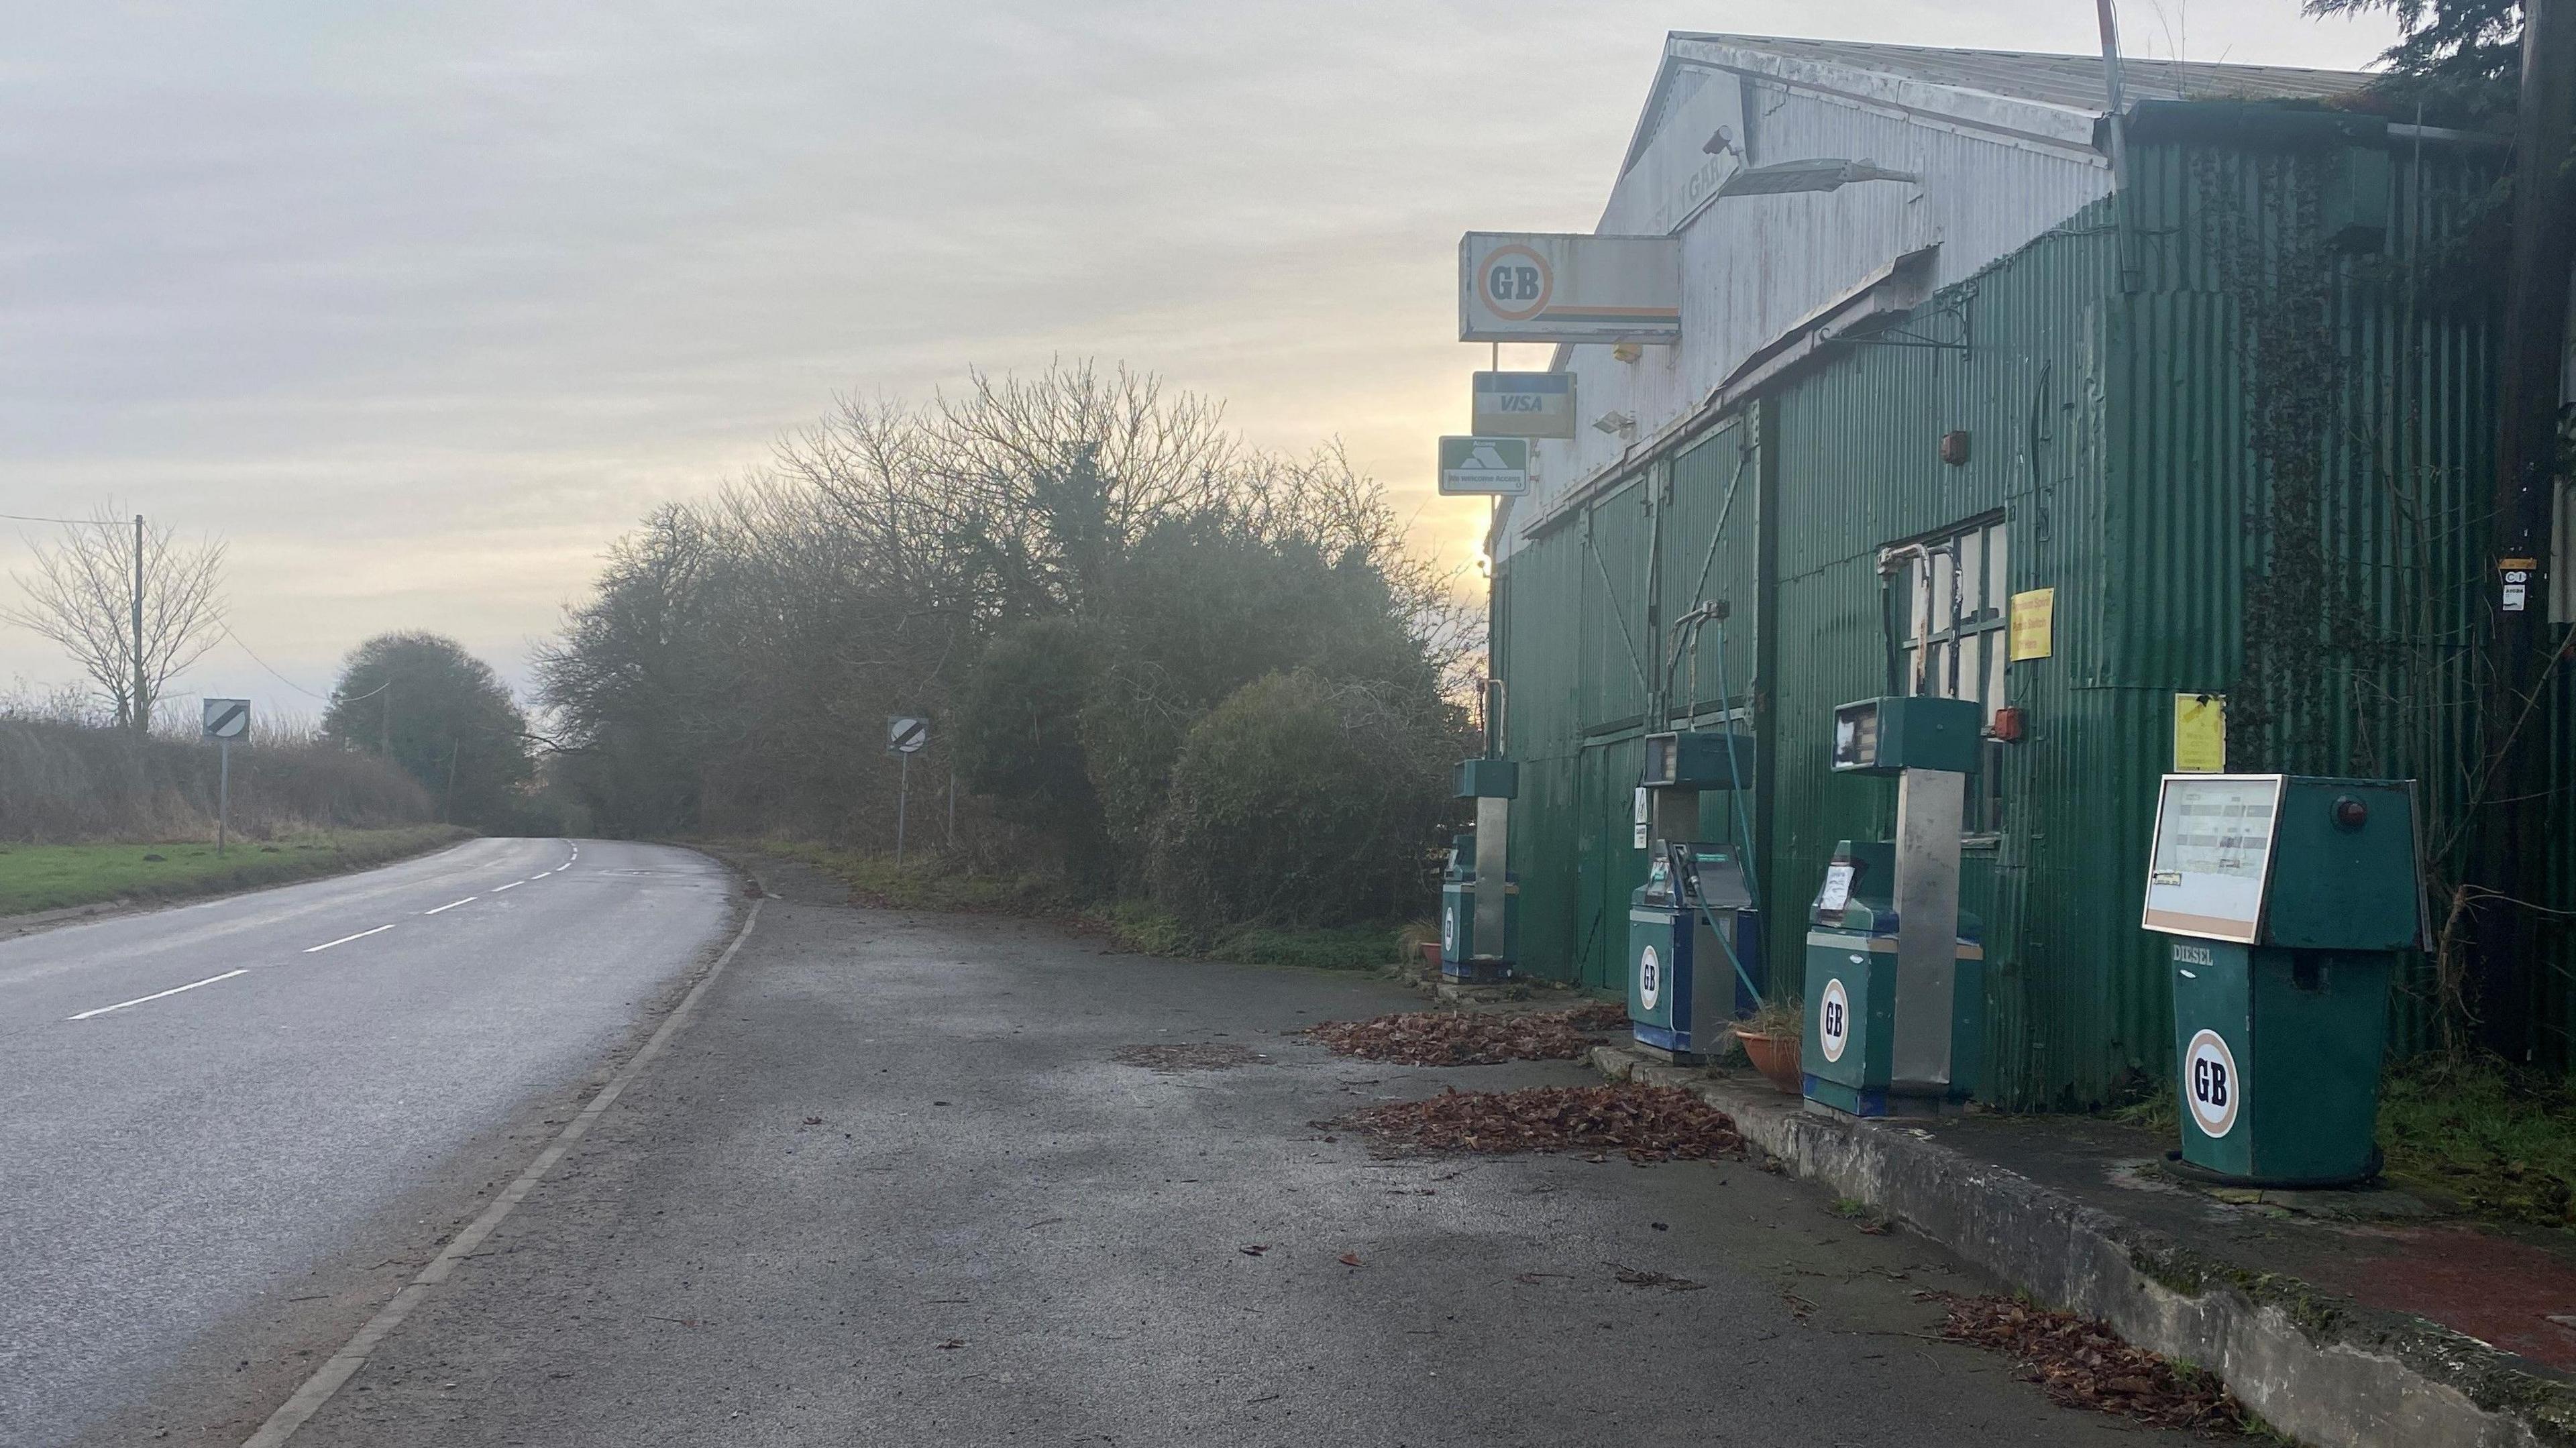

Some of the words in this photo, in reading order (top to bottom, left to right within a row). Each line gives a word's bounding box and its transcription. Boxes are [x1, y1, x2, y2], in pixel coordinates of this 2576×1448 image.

[1491, 266, 1539, 300] GB
[1501, 396, 1543, 411] VISA
[2174, 944, 2213, 966] DIESEL
[1644, 964, 1655, 991] GB
[1826, 1001, 1842, 1037] GB
[2195, 1058, 2227, 1107] GB
